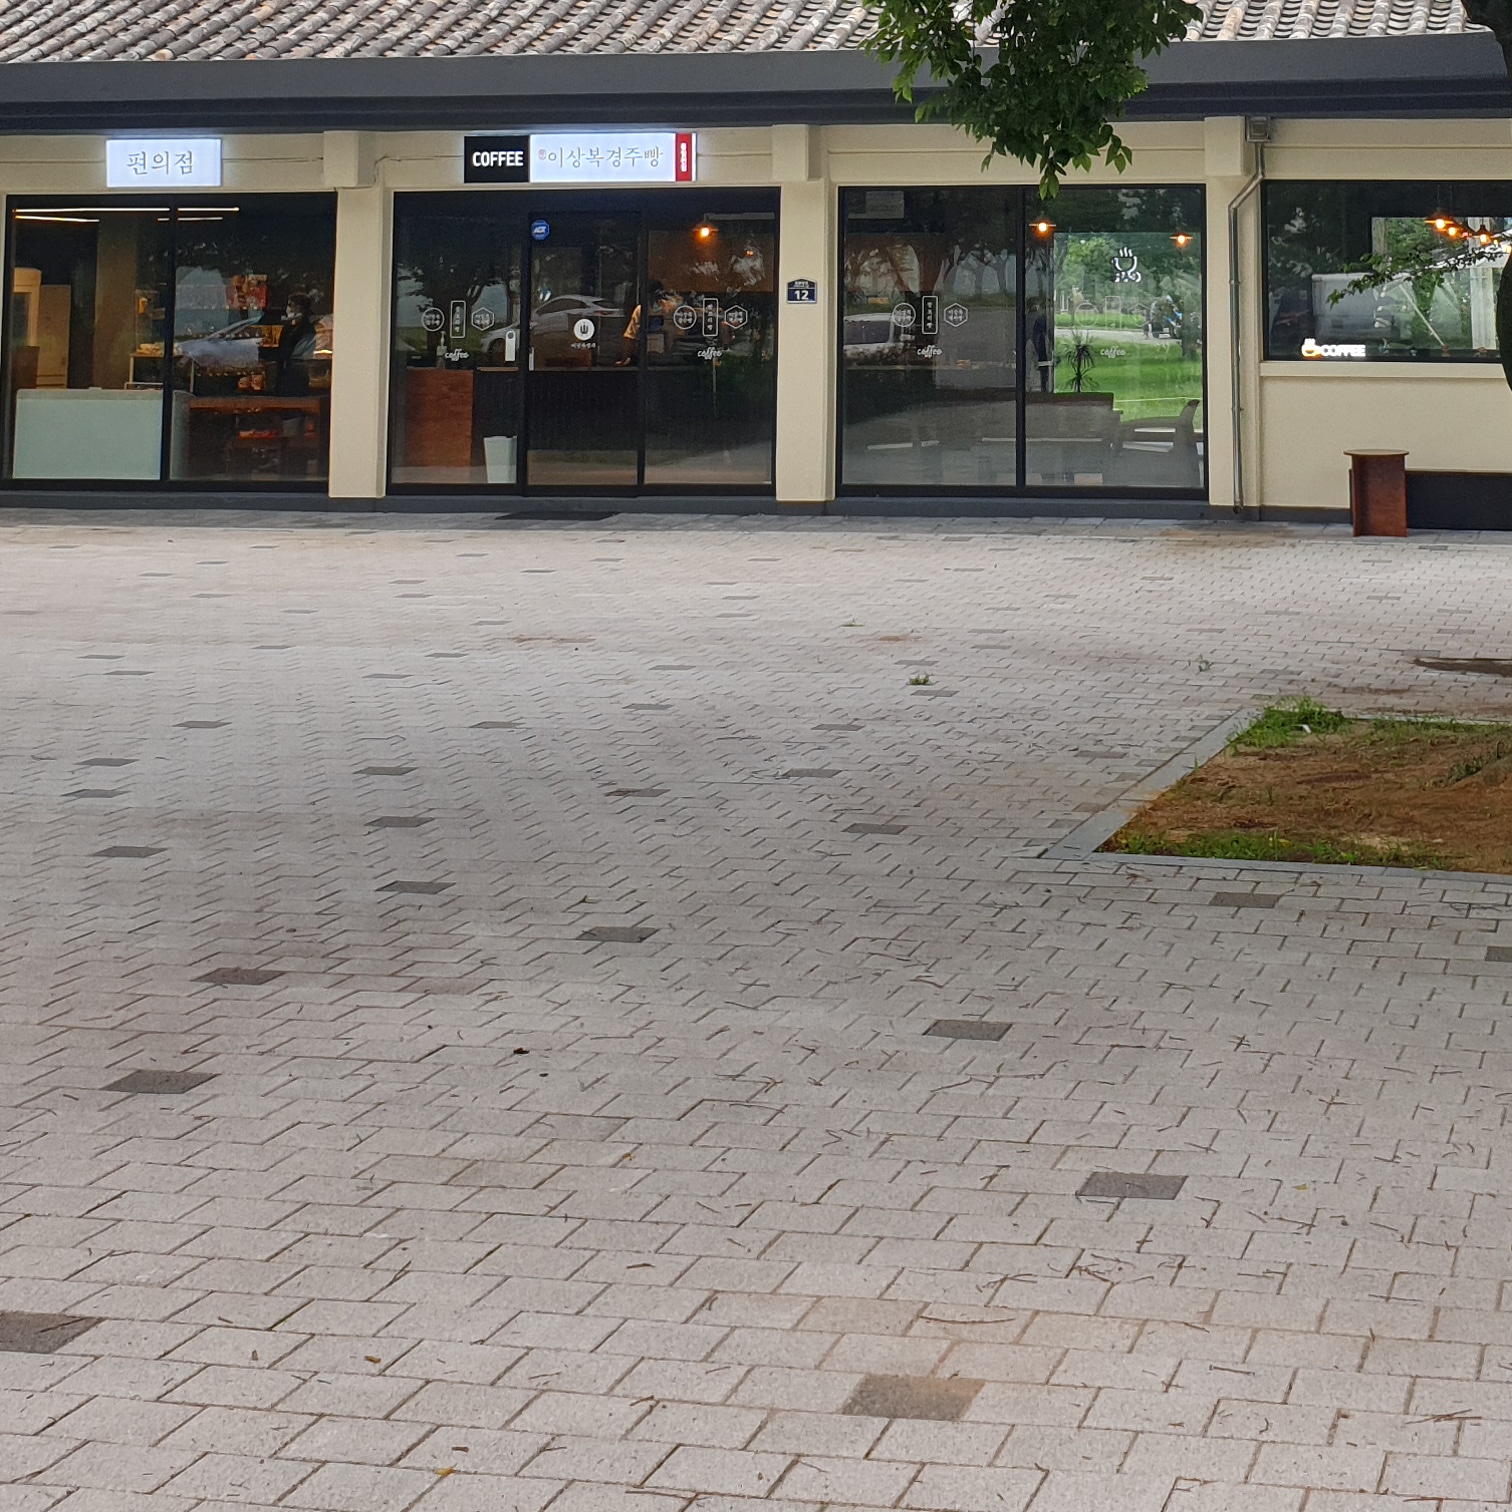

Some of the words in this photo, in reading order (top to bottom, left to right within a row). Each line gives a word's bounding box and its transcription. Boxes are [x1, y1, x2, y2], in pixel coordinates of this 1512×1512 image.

[127, 150, 193, 175] 편의점
[472, 151, 524, 167] COFFEE
[548, 146, 664, 168] 이상복경주빵
[794, 289, 809, 300] 12
[444, 348, 469, 362] coffee
[697, 347, 723, 360] coffee
[917, 344, 943, 358] coffee
[1100, 346, 1126, 359] coffee
[1320, 344, 1366, 357] COFFEE
